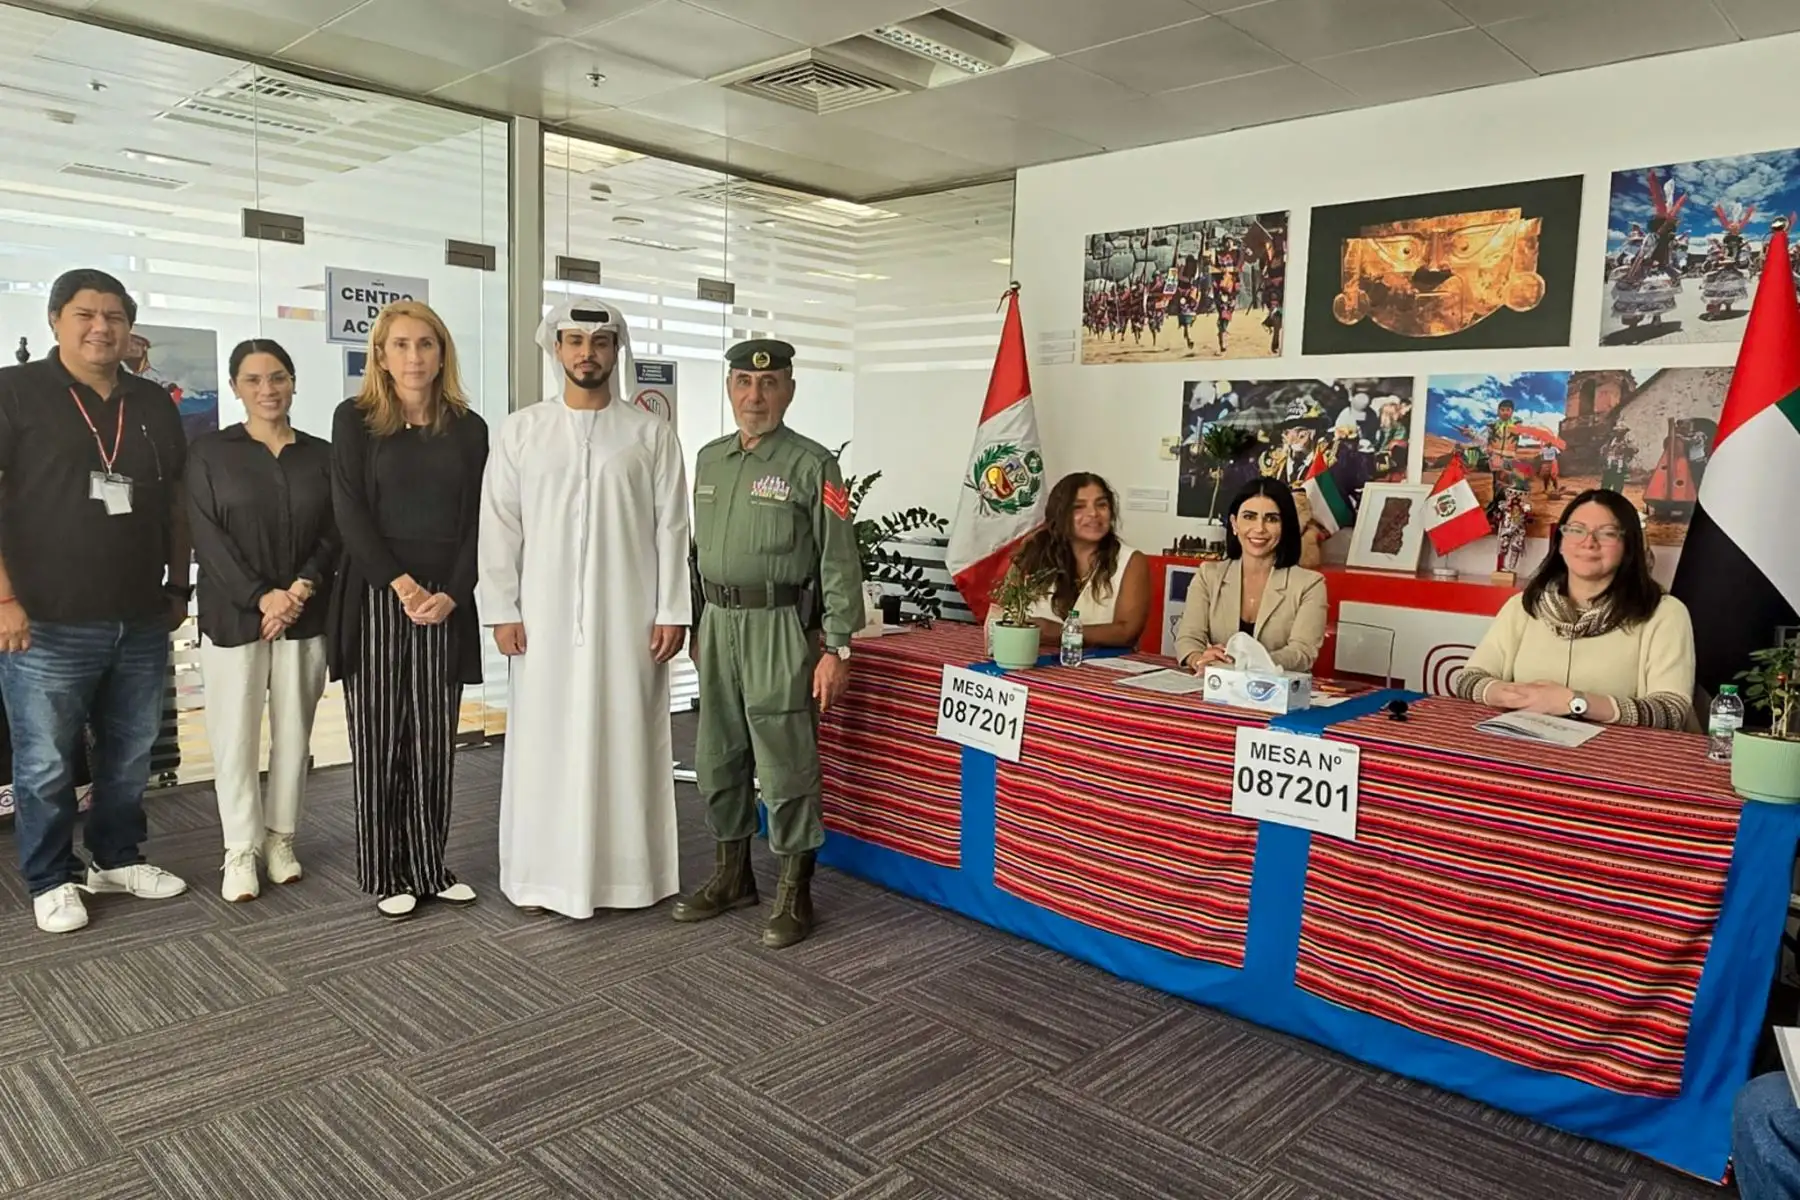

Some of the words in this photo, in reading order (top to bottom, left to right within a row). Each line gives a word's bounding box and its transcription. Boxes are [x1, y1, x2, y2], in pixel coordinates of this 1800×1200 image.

[368, 306, 384, 319] D
[952, 677, 994, 703] MESA
[942, 697, 1018, 740] 087201
[1250, 741, 1312, 768] MESA
[1237, 766, 1348, 813] 087201
